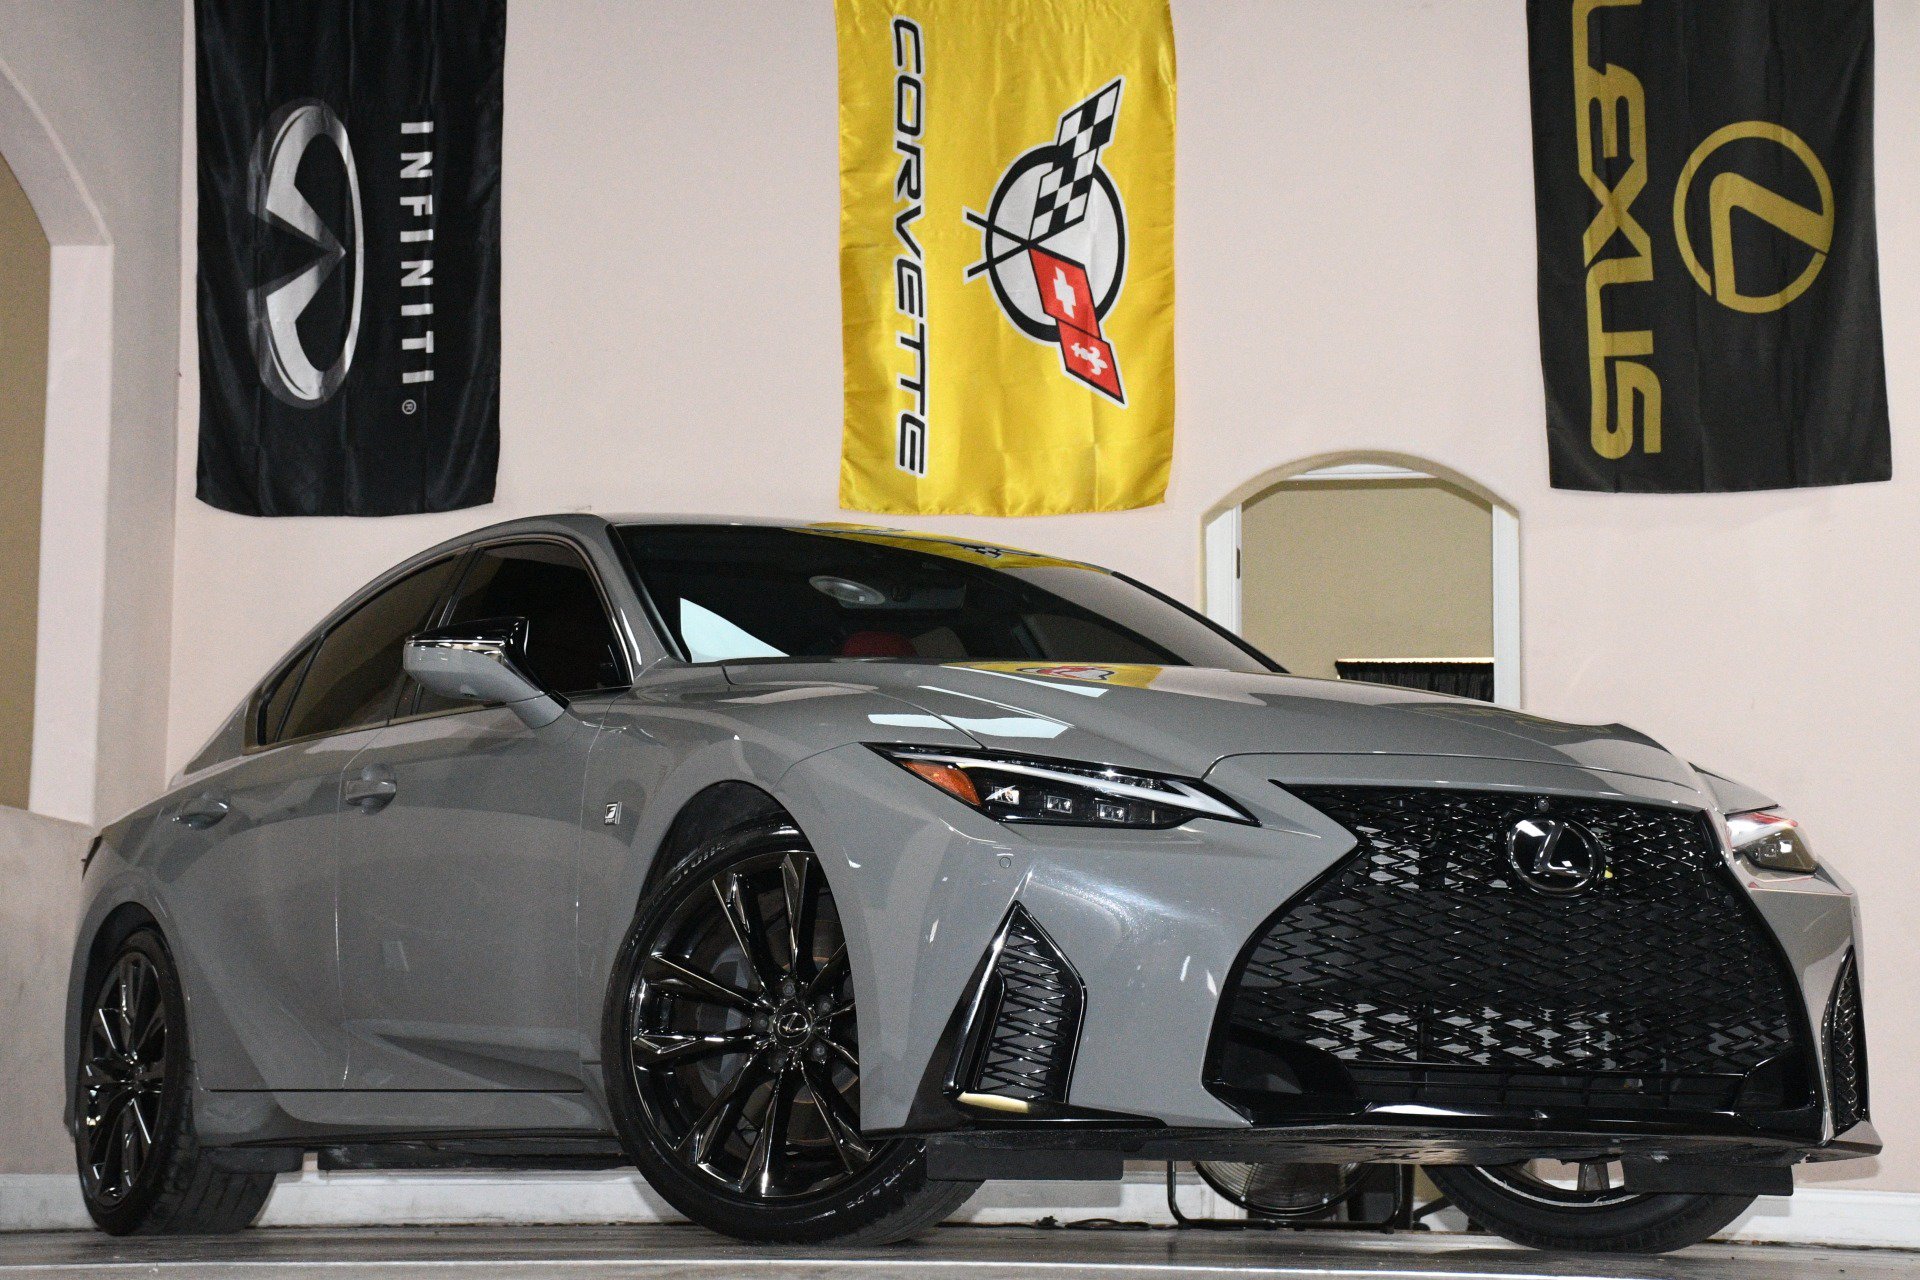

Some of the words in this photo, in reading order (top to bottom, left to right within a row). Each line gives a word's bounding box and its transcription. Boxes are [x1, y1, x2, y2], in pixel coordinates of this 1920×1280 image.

[400, 120, 434, 385] INFINITI
[893, 17, 926, 476] CORVETTE
[1572, 0, 1662, 460] LEXUS
